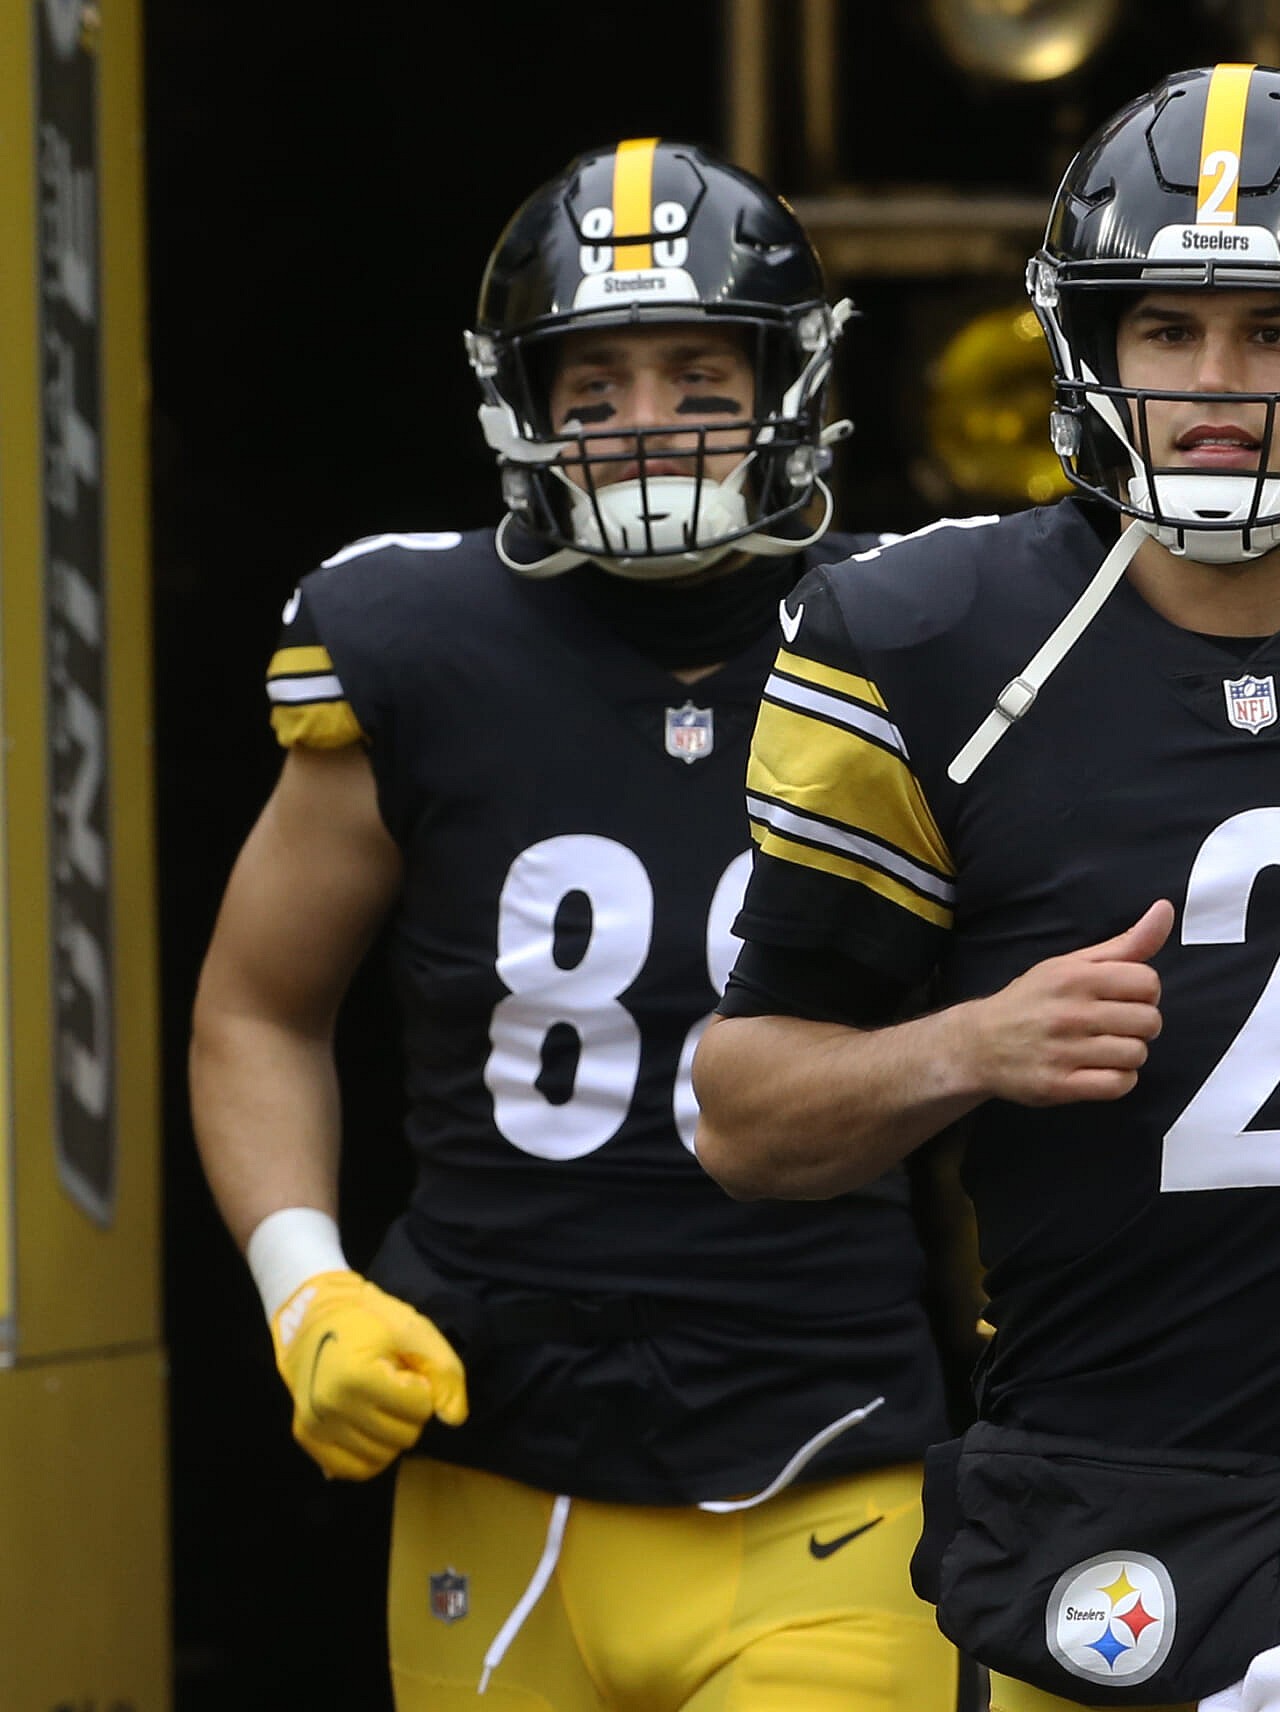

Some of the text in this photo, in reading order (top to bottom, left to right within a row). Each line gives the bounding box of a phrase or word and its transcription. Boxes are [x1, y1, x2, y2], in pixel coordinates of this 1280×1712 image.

[1196, 150, 1240, 224] 2
[1182, 230, 1249, 250] Steelers
[604, 274, 666, 293] Steelers
[1236, 699, 1270, 722] NFL
[1066, 1606, 1105, 1621] Steelers
